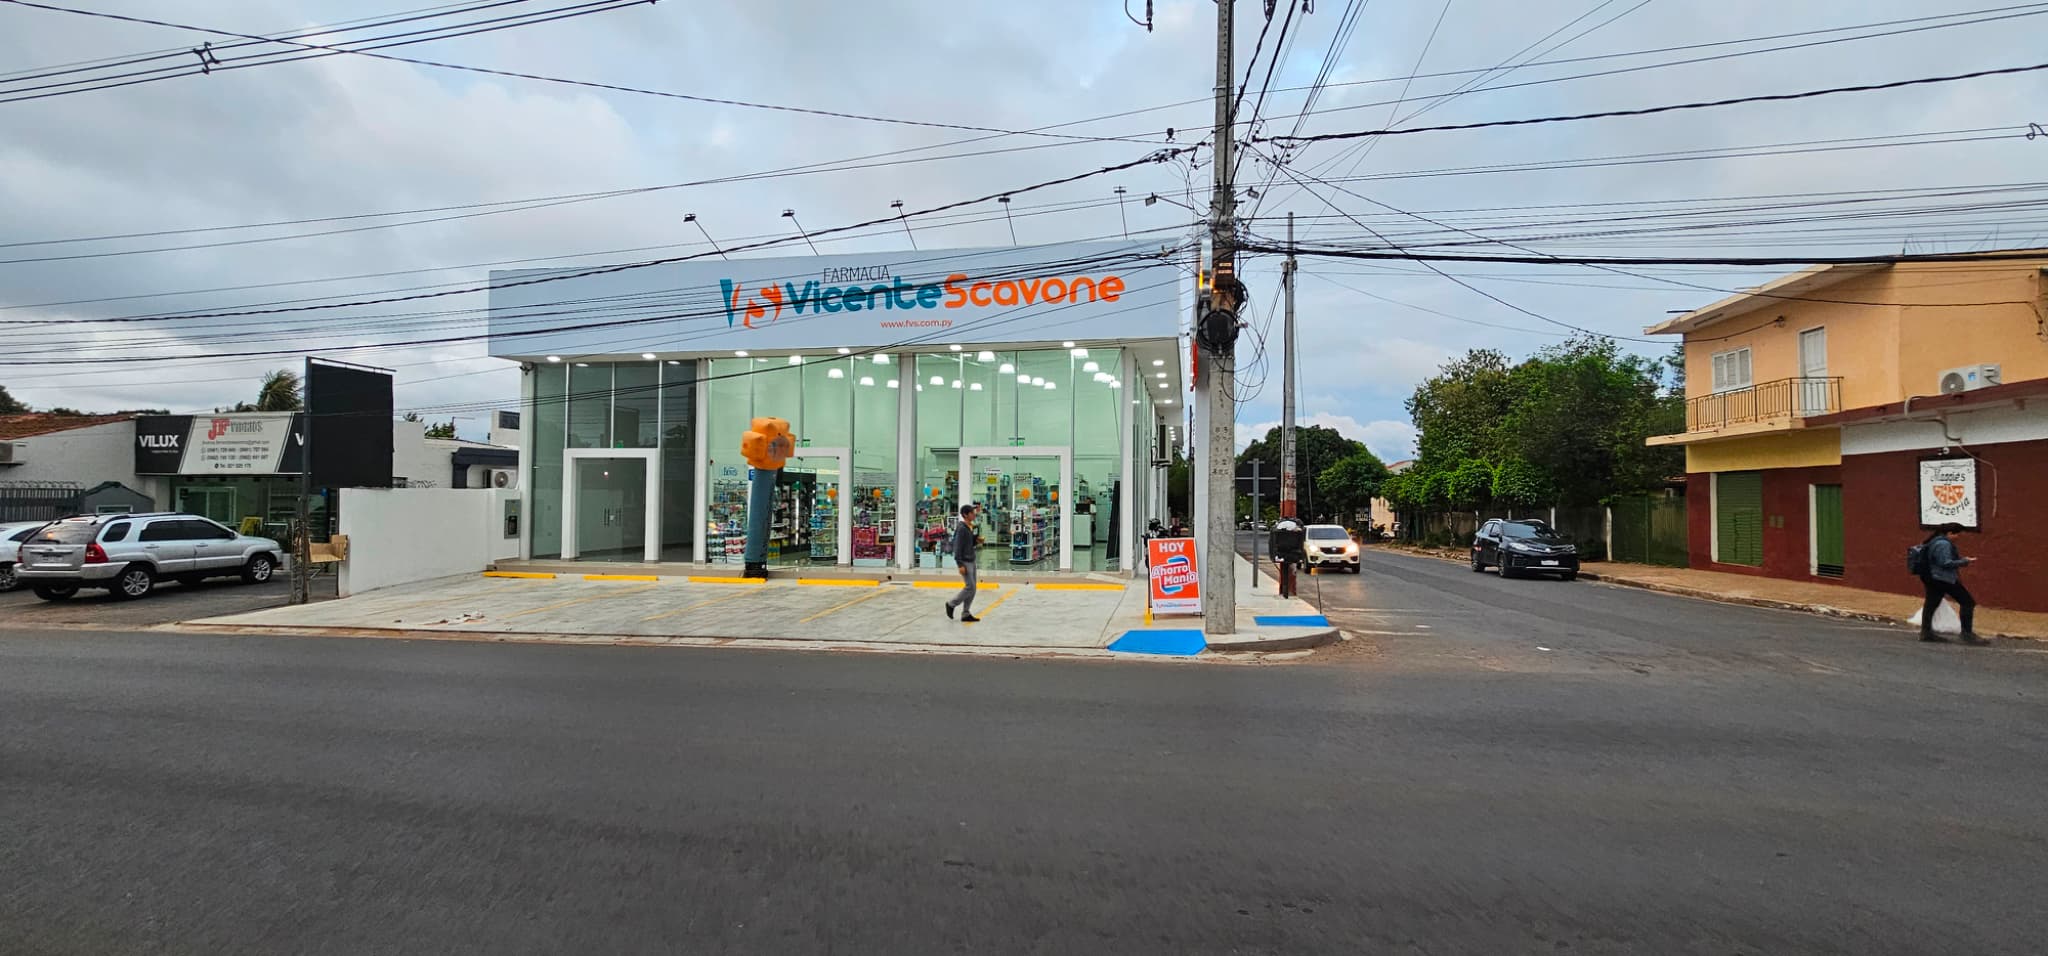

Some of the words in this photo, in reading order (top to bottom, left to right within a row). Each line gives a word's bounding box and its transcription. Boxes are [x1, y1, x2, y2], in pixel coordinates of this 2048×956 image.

[823, 265, 890, 283] FARMACIA
[880, 319, 953, 328] www.fvs.com.py
[139, 435, 179, 448] VILUX
[1159, 542, 1185, 553] HOY
[1152, 565, 1188, 578] Ahorro
